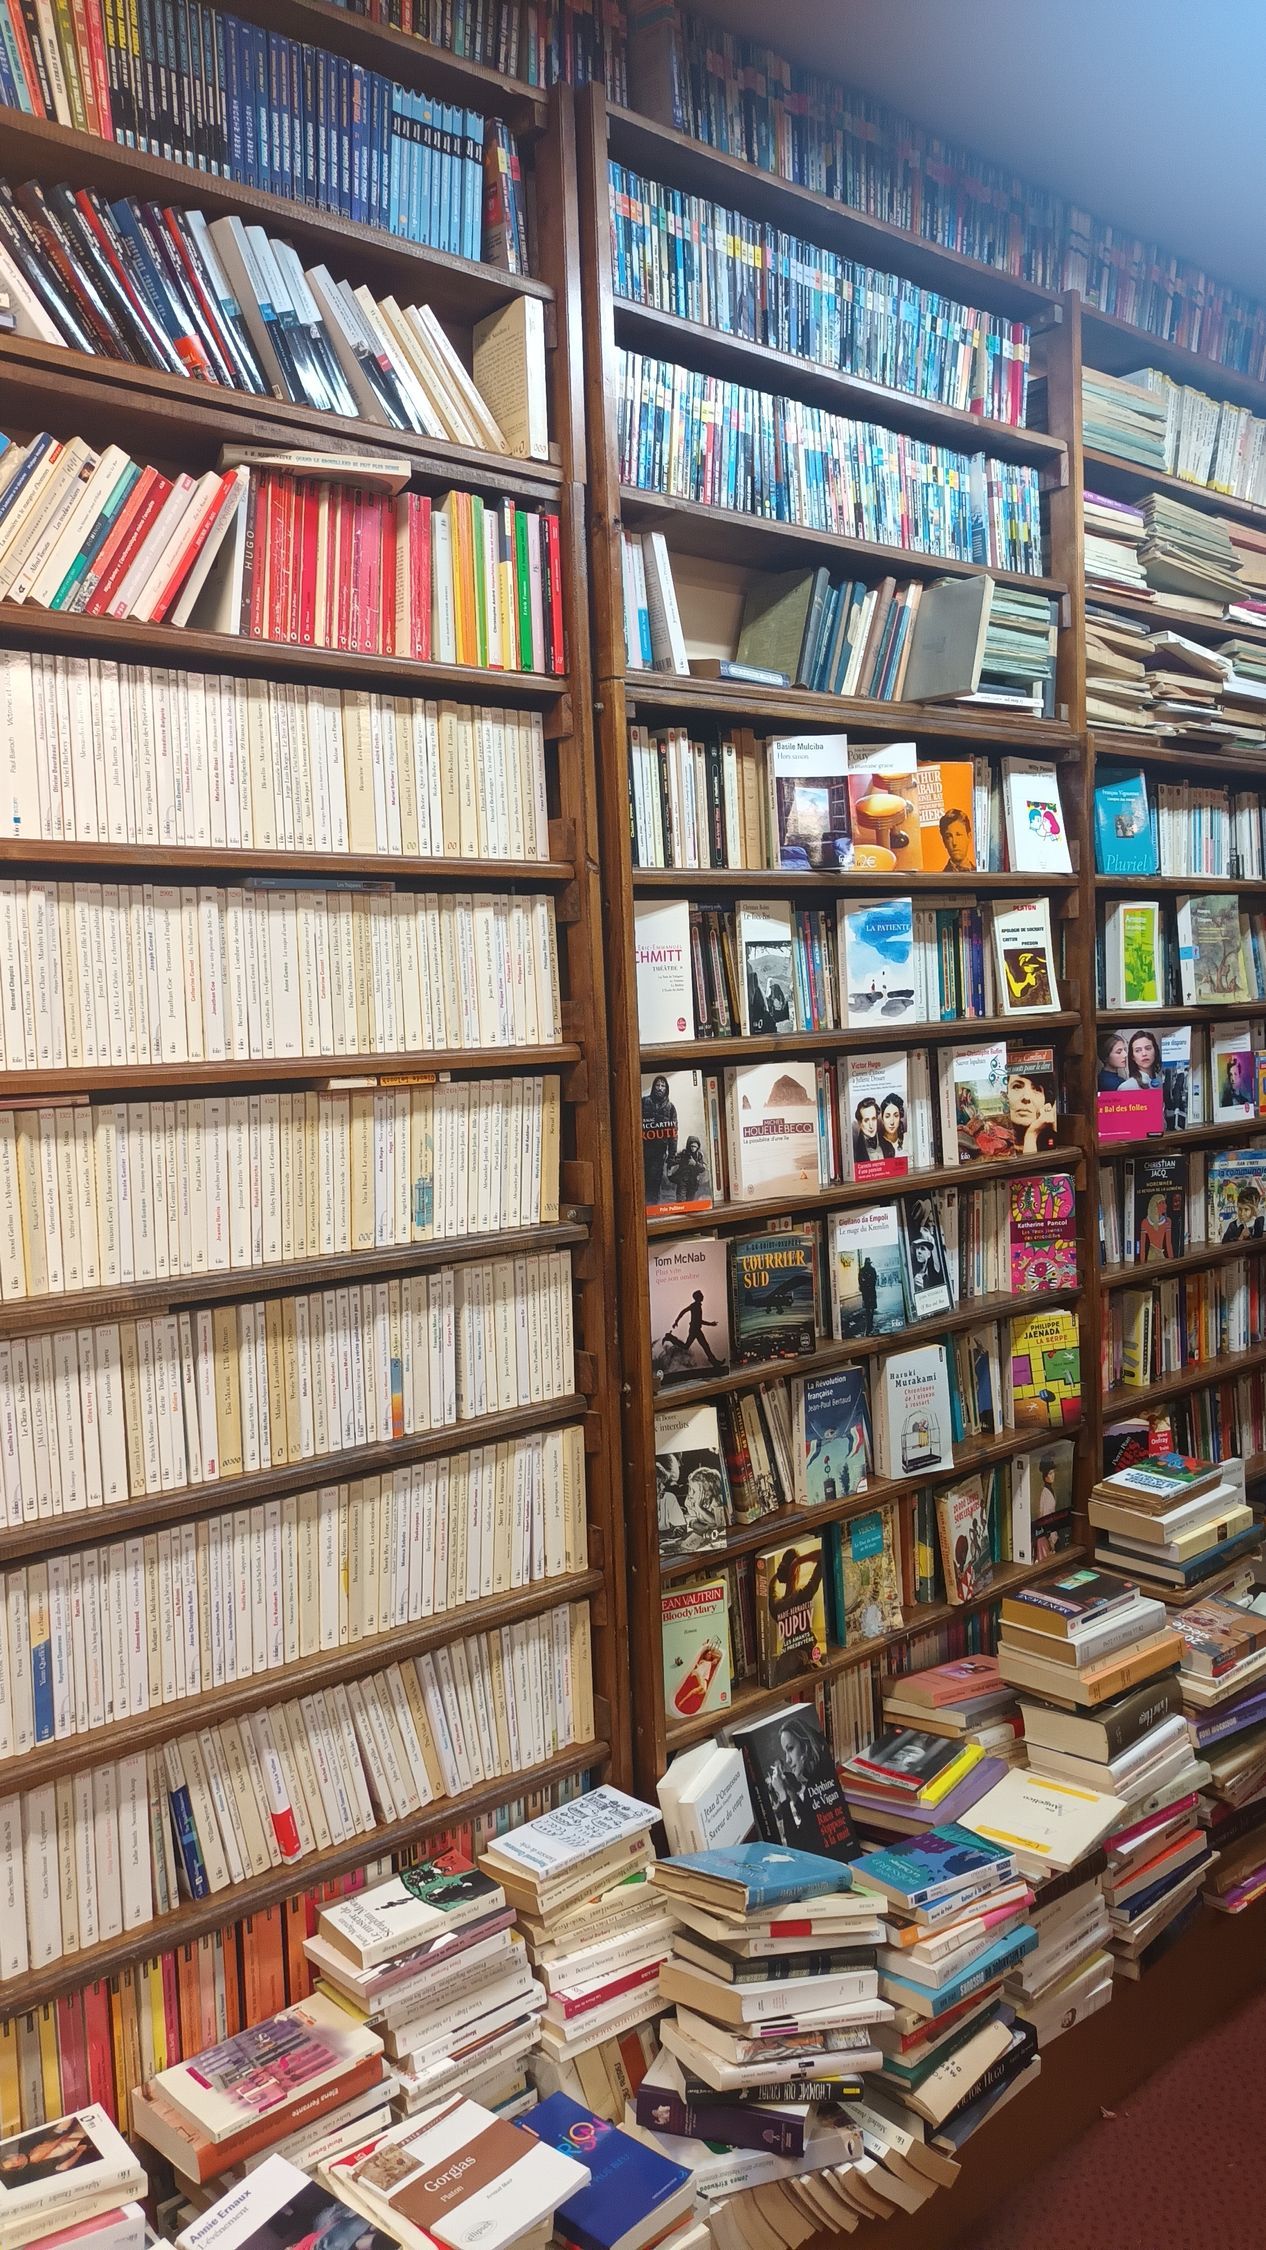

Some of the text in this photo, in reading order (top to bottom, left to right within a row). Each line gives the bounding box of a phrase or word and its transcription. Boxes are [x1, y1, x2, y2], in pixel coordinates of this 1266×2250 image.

[245, 531, 255, 570] HUGO
[848, 751, 869, 762] Pouy
[1106, 854, 1148, 872] Pluriel
[36, 905, 44, 927] Dingue
[36, 935, 45, 960] Marilyn
[164, 942, 172, 972] Testament
[38, 966, 46, 989] Charyn
[95, 940, 105, 998] Jean Clair Journal
[40, 991, 49, 1013] Jerome
[83, 983, 91, 1011] Chevalier
[167, 991, 176, 1019] Jonathan
[956, 1049, 989, 1057] Jean-Christophe
[970, 1058, 986, 1066] Ispahan
[1025, 1064, 1036, 1072] pour
[1104, 1105, 1115, 1113] Bal
[1116, 1104, 1127, 1112] des
[1129, 1104, 1147, 1112] folles
[744, 1124, 812, 1136] HOUELLEBECQ
[1144, 1159, 1175, 1168] CHRISTIAN
[154, 1154, 163, 1202] Camille Laurens
[1151, 1169, 1168, 1179] JACQ
[82, 1168, 92, 1207] David Goodis
[46, 1188, 56, 1235] Valentine Goby
[839, 1216, 861, 1226] Giuliano
[870, 1213, 889, 1223] Empoli
[106, 1206, 115, 1251] Romain Gary
[847, 1226, 860, 1235] mage
[868, 1224, 889, 1232] Kremlin
[1017, 1219, 1067, 1229] Katherine Pancol
[654, 1252, 705, 1267] Tom McNab
[742, 1250, 805, 1272] COURRIER
[656, 1268, 669, 1276] Plus
[680, 1272, 700, 1280] ombre
[744, 1271, 770, 1288] SUD
[891, 1319, 903, 1327] folio
[1030, 1321, 1060, 1331] PHILIPPE
[1024, 1328, 1060, 1339] JAENADA
[1046, 1334, 1068, 1343] SERPE
[102, 1349, 110, 1369] L'aveu
[814, 1376, 846, 1389] Révolution
[890, 1369, 916, 1380] Haruki
[895, 1374, 937, 1388] Murakami
[104, 1374, 112, 1398] London
[807, 1389, 833, 1401] française
[904, 1386, 935, 1395] Chroniques
[16, 1360, 29, 1437] Le Clézio Étoile errante
[808, 1396, 851, 1413] Jean-Paul Bertaud
[910, 1400, 930, 1408] ressort
[912, 1392, 935, 1401] l'oiseau
[660, 1422, 689, 1432] interdits
[1151, 1437, 1168, 1445] Onfray
[662, 1589, 721, 1610] EAN VAUTRIN
[663, 1604, 717, 1622] Bloody Mary
[778, 1609, 814, 1638] DUPUY
[792, 1632, 810, 1644] AMANTS
[703, 1771, 741, 1821] Jean d'Ormesson
[807, 1779, 834, 1798] Delphine
[812, 1791, 839, 1810] de Vigan
[709, 1794, 744, 1840] Saveur du temps
[816, 1807, 843, 1825] Rien ne
[820, 1816, 846, 1835] s'oppose
[837, 1827, 849, 1841] nuit
[503, 1842, 549, 1867] Raymond Queneau
[349, 1912, 383, 1943] Le mystère
[365, 1912, 394, 1938] Séraphin
[357, 1933, 371, 1947] Pierre
[454, 2005, 468, 2017] Hugo
[798, 2083, 831, 2100] L'HOMME
[292, 2087, 339, 2117] Elena Ferrante
[424, 2154, 476, 2194] Gorgias
[699, 2175, 748, 2193] James Kirkwood
[440, 2184, 464, 2203] Platon
[189, 2190, 252, 2244] Annie Ernaux
